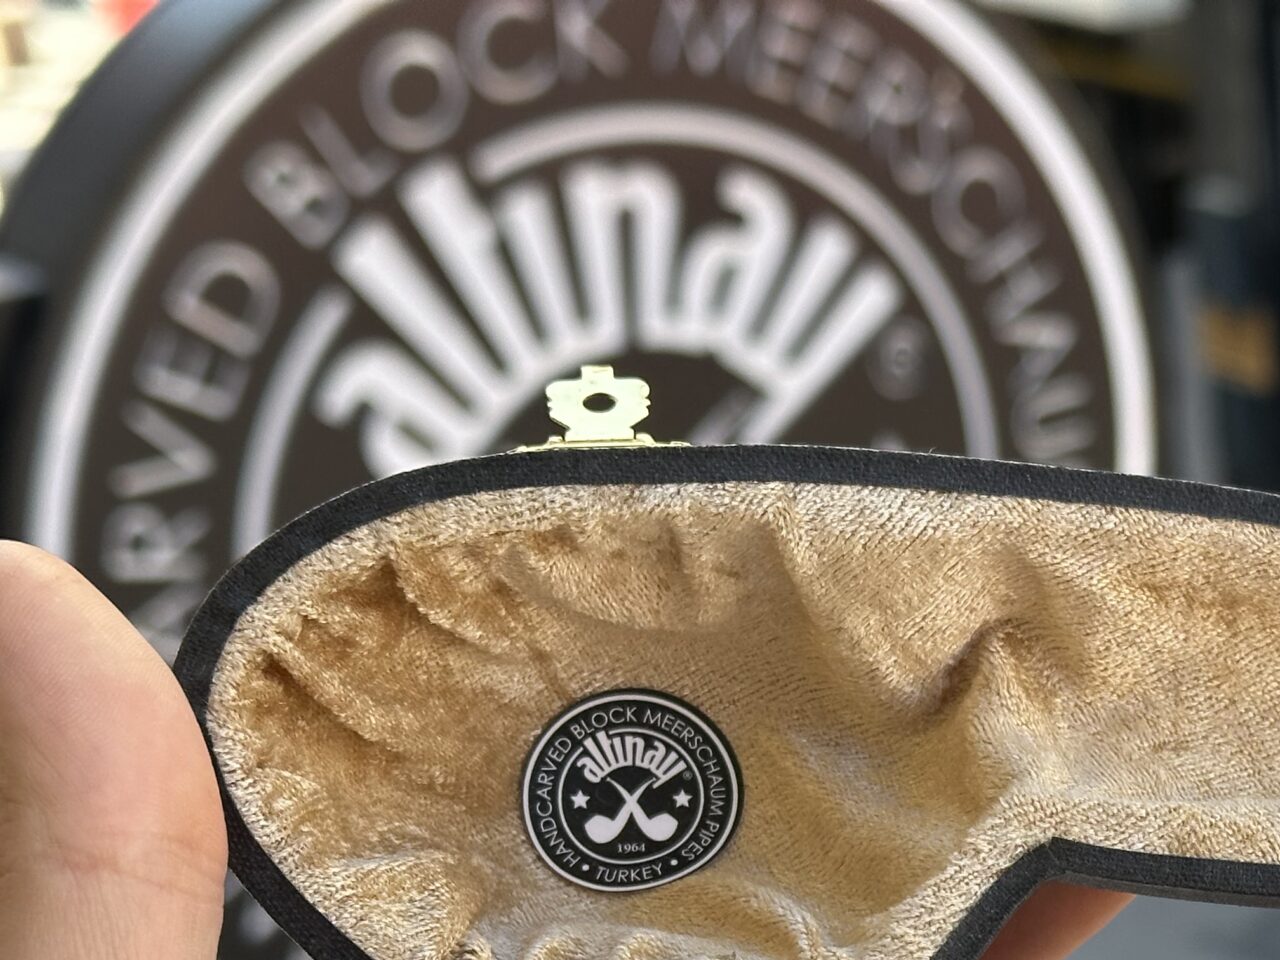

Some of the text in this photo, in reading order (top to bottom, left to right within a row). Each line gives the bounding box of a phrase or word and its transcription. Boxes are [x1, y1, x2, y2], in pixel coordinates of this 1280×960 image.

[244, 0, 630, 250] BLOCK
[648, 0, 1098, 462] MEERSCHAU
[536, 706, 726, 868] HANDCARVED BLOCK MEERSCHAUM PIPES
[595, 862, 663, 883] TURKEY
[617, 842, 646, 854] 1964
